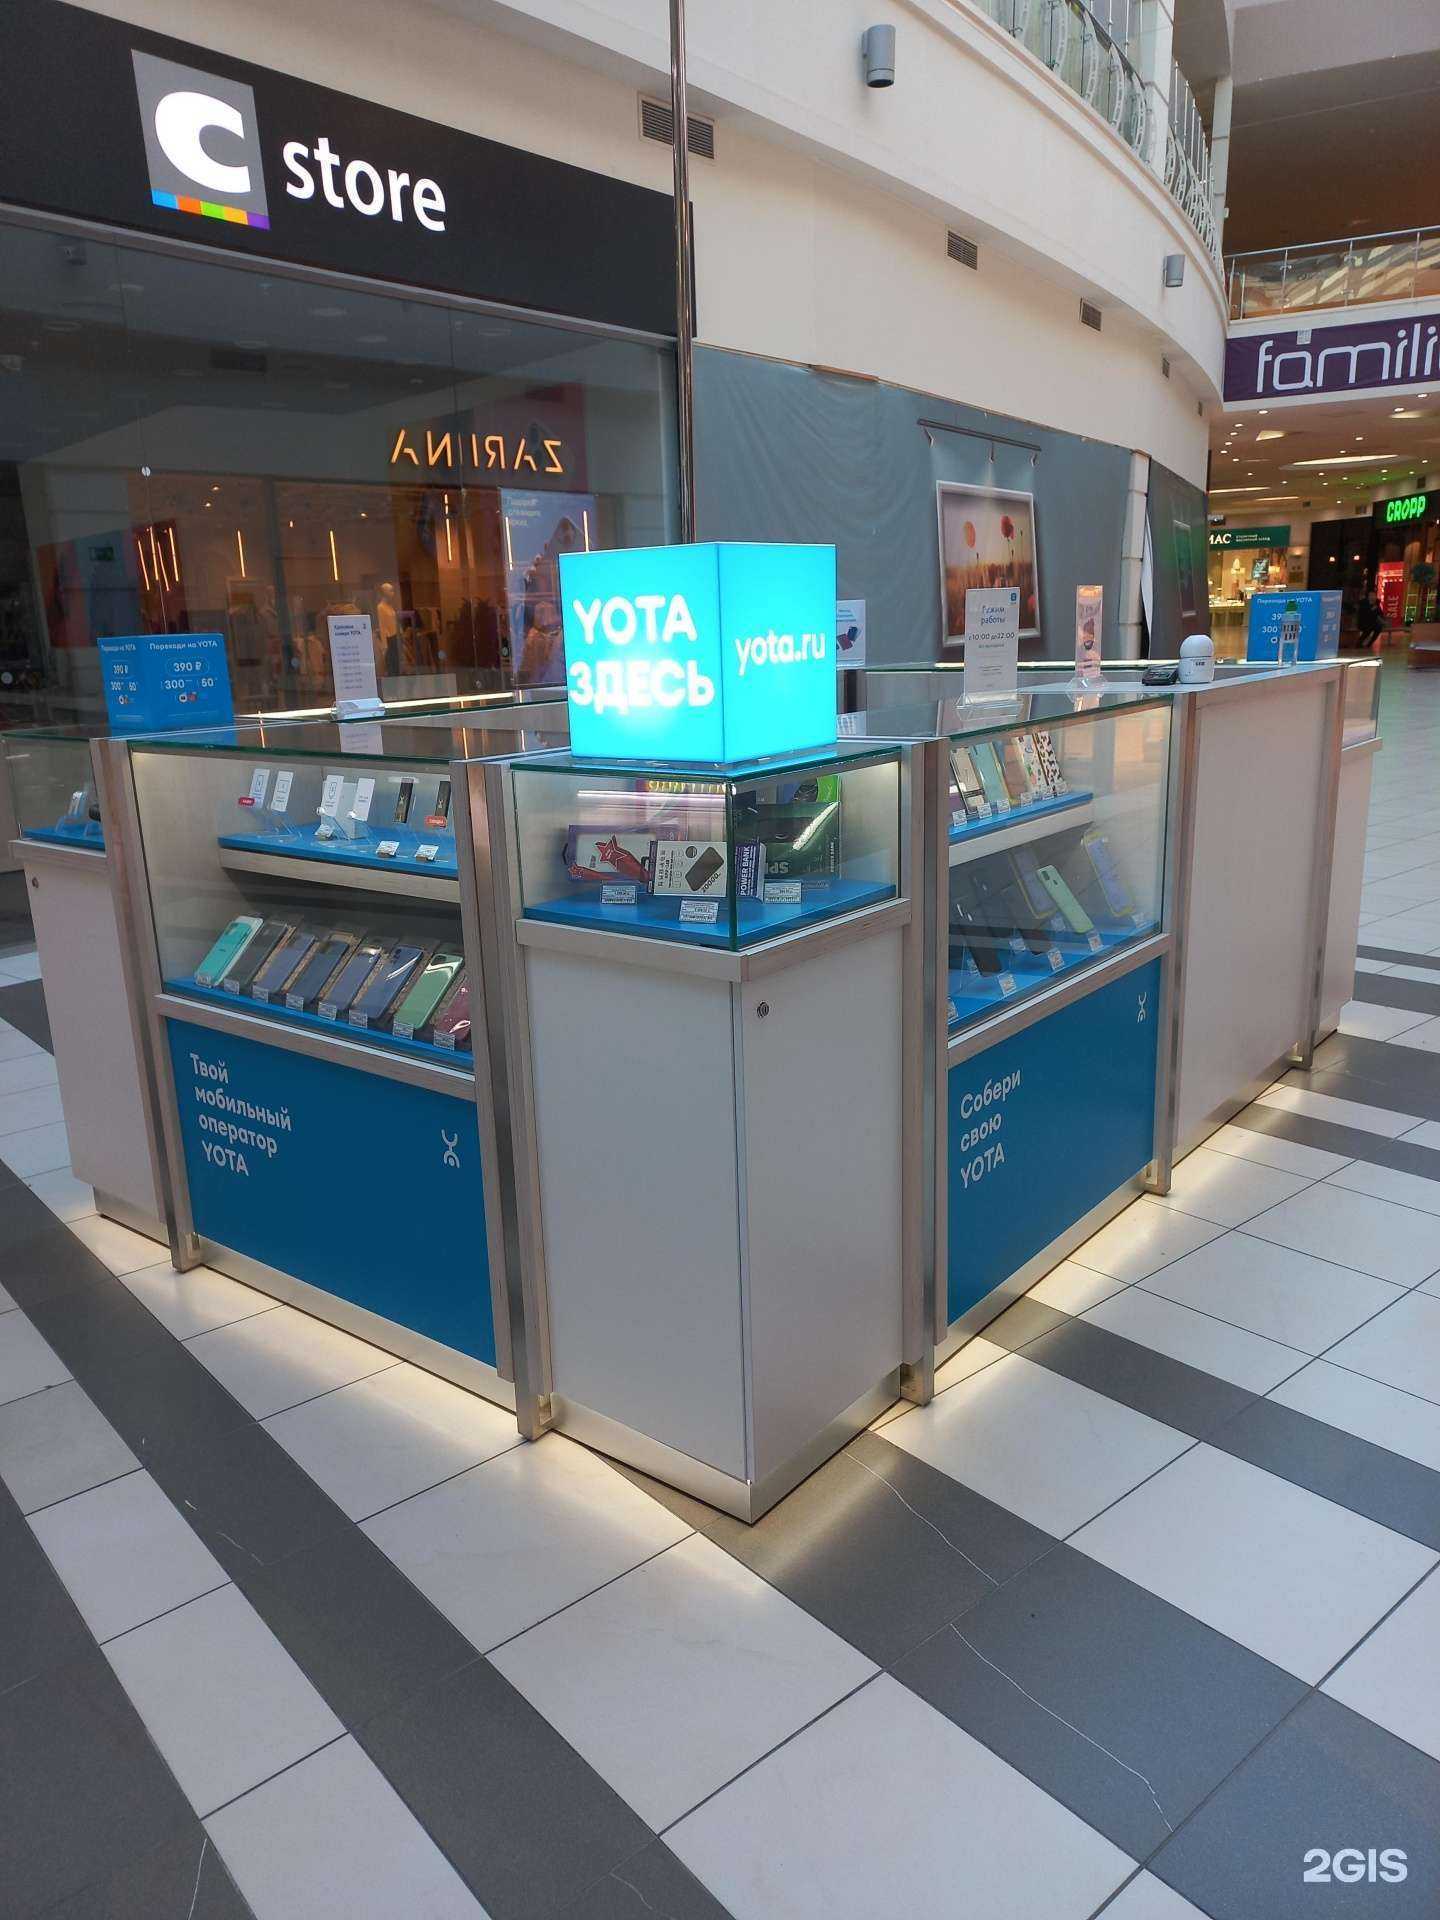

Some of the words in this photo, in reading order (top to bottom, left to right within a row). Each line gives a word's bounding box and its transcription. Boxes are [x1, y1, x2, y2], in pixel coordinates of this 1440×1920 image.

[282, 136, 447, 232] store
[1256, 323, 1440, 393] famili
[1386, 495, 1426, 522] CROPP
[572, 593, 698, 646] YOTA
[198, 640, 218, 648] YOTA
[734, 630, 827, 676] yota.ru
[173, 662, 193, 672] 390
[568, 658, 715, 716] ЗДЕСЬ
[742, 845, 751, 867] BANK
[739, 865, 750, 896] POWER
[190, 1052, 229, 1084] Твой
[195, 1085, 292, 1131] мобильный
[960, 1069, 1022, 1119] Собери
[198, 1113, 278, 1158] оператор
[960, 1113, 1002, 1152] свою
[201, 1139, 249, 1176] YOTA
[960, 1142, 1006, 1189] YOTA
